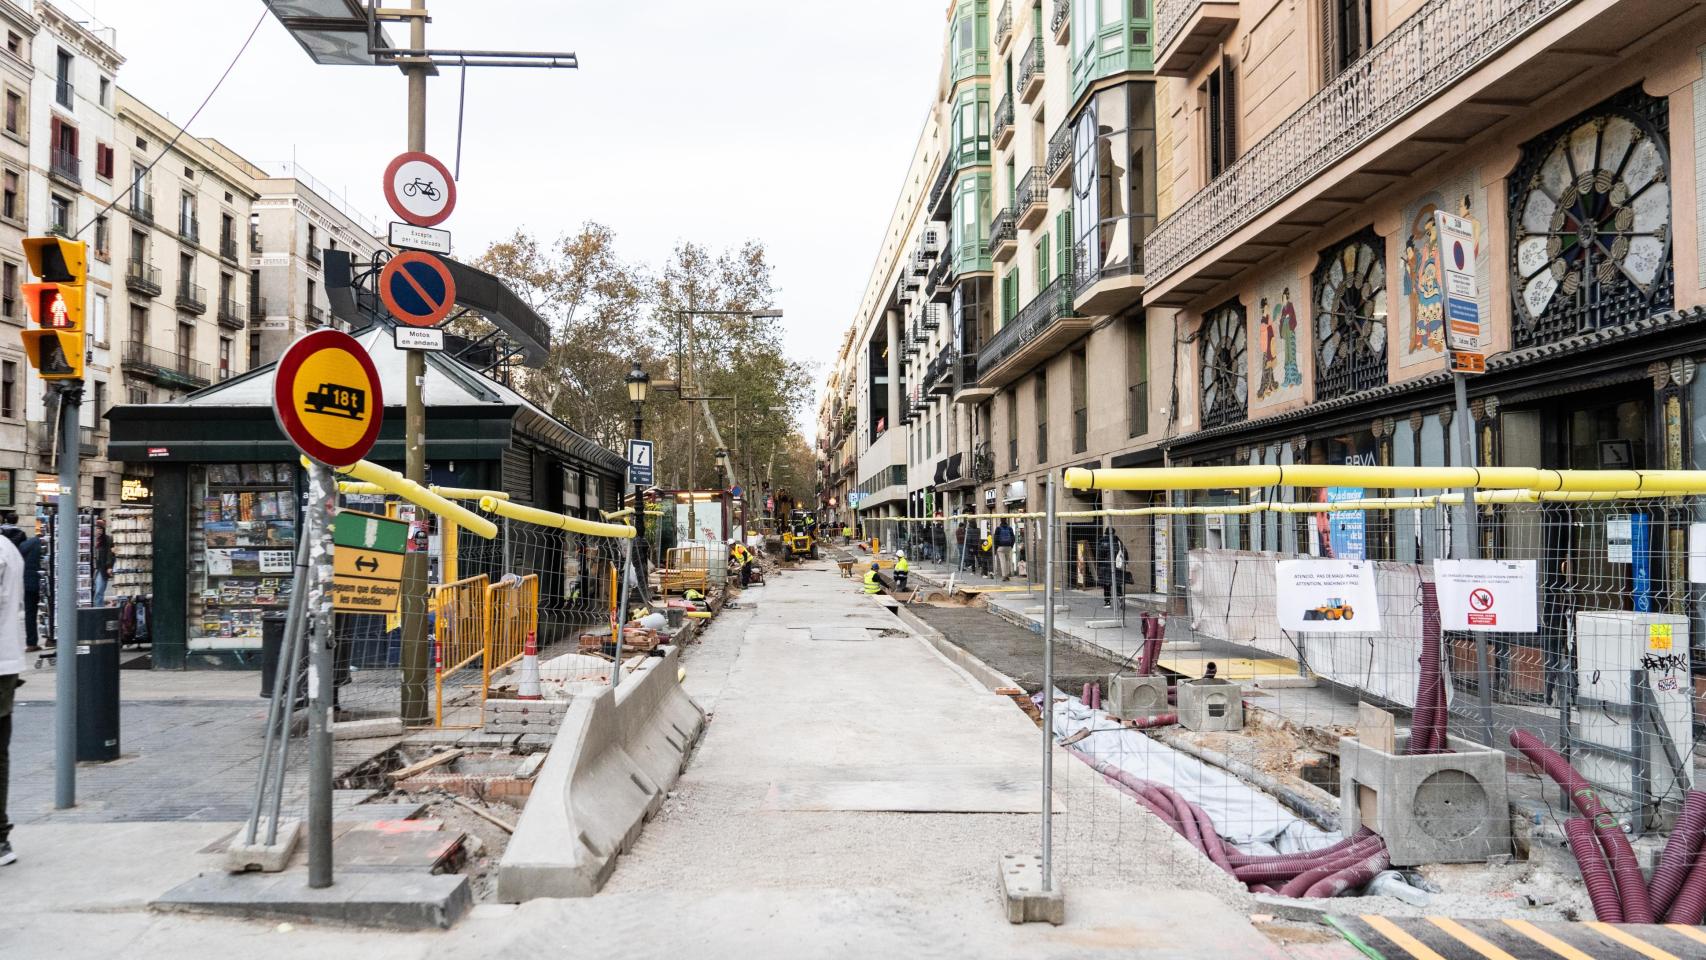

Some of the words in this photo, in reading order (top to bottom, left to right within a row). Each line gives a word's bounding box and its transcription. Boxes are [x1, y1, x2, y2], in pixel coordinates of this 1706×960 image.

[409, 330, 431, 339] Motos
[413, 338, 439, 347] andana
[1345, 451, 1377, 466] BBVA
[357, 584, 369, 594] que
